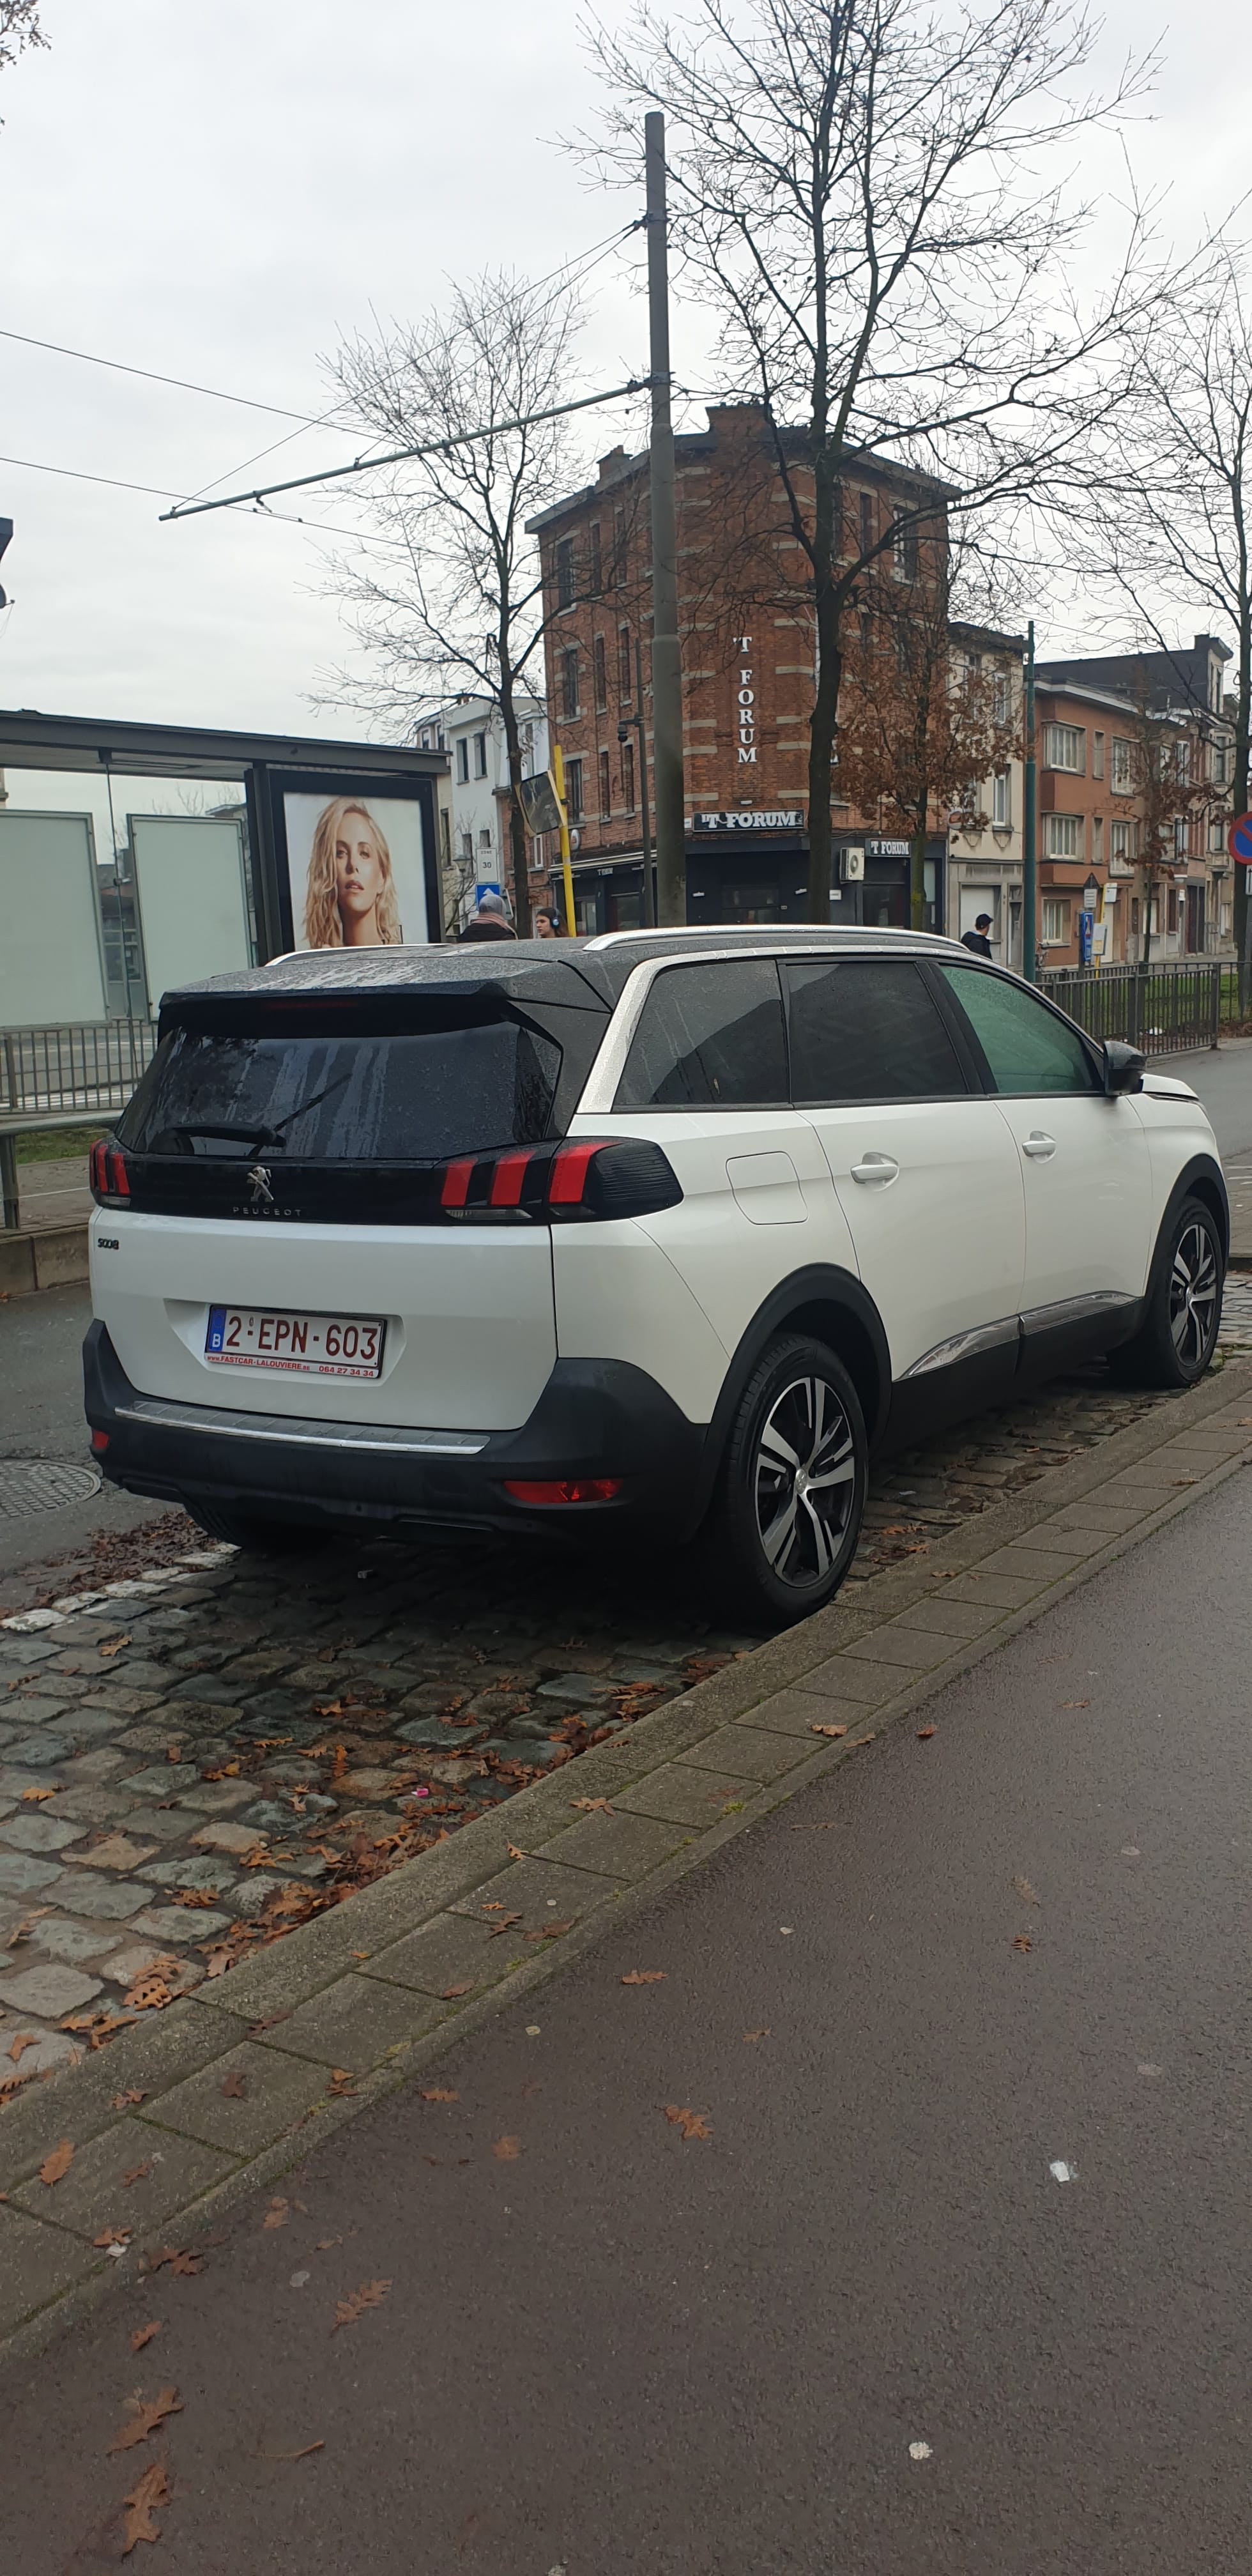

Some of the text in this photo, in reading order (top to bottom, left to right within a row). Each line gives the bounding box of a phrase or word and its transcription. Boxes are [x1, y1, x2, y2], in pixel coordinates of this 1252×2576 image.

[738, 669, 758, 763] FORUM
[725, 811, 798, 828] FORUM
[881, 841, 909, 855] FORUM
[233, 1206, 303, 1217] PEUGEOT
[97, 1238, 119, 1250] 5008
[212, 1333, 221, 1348] B
